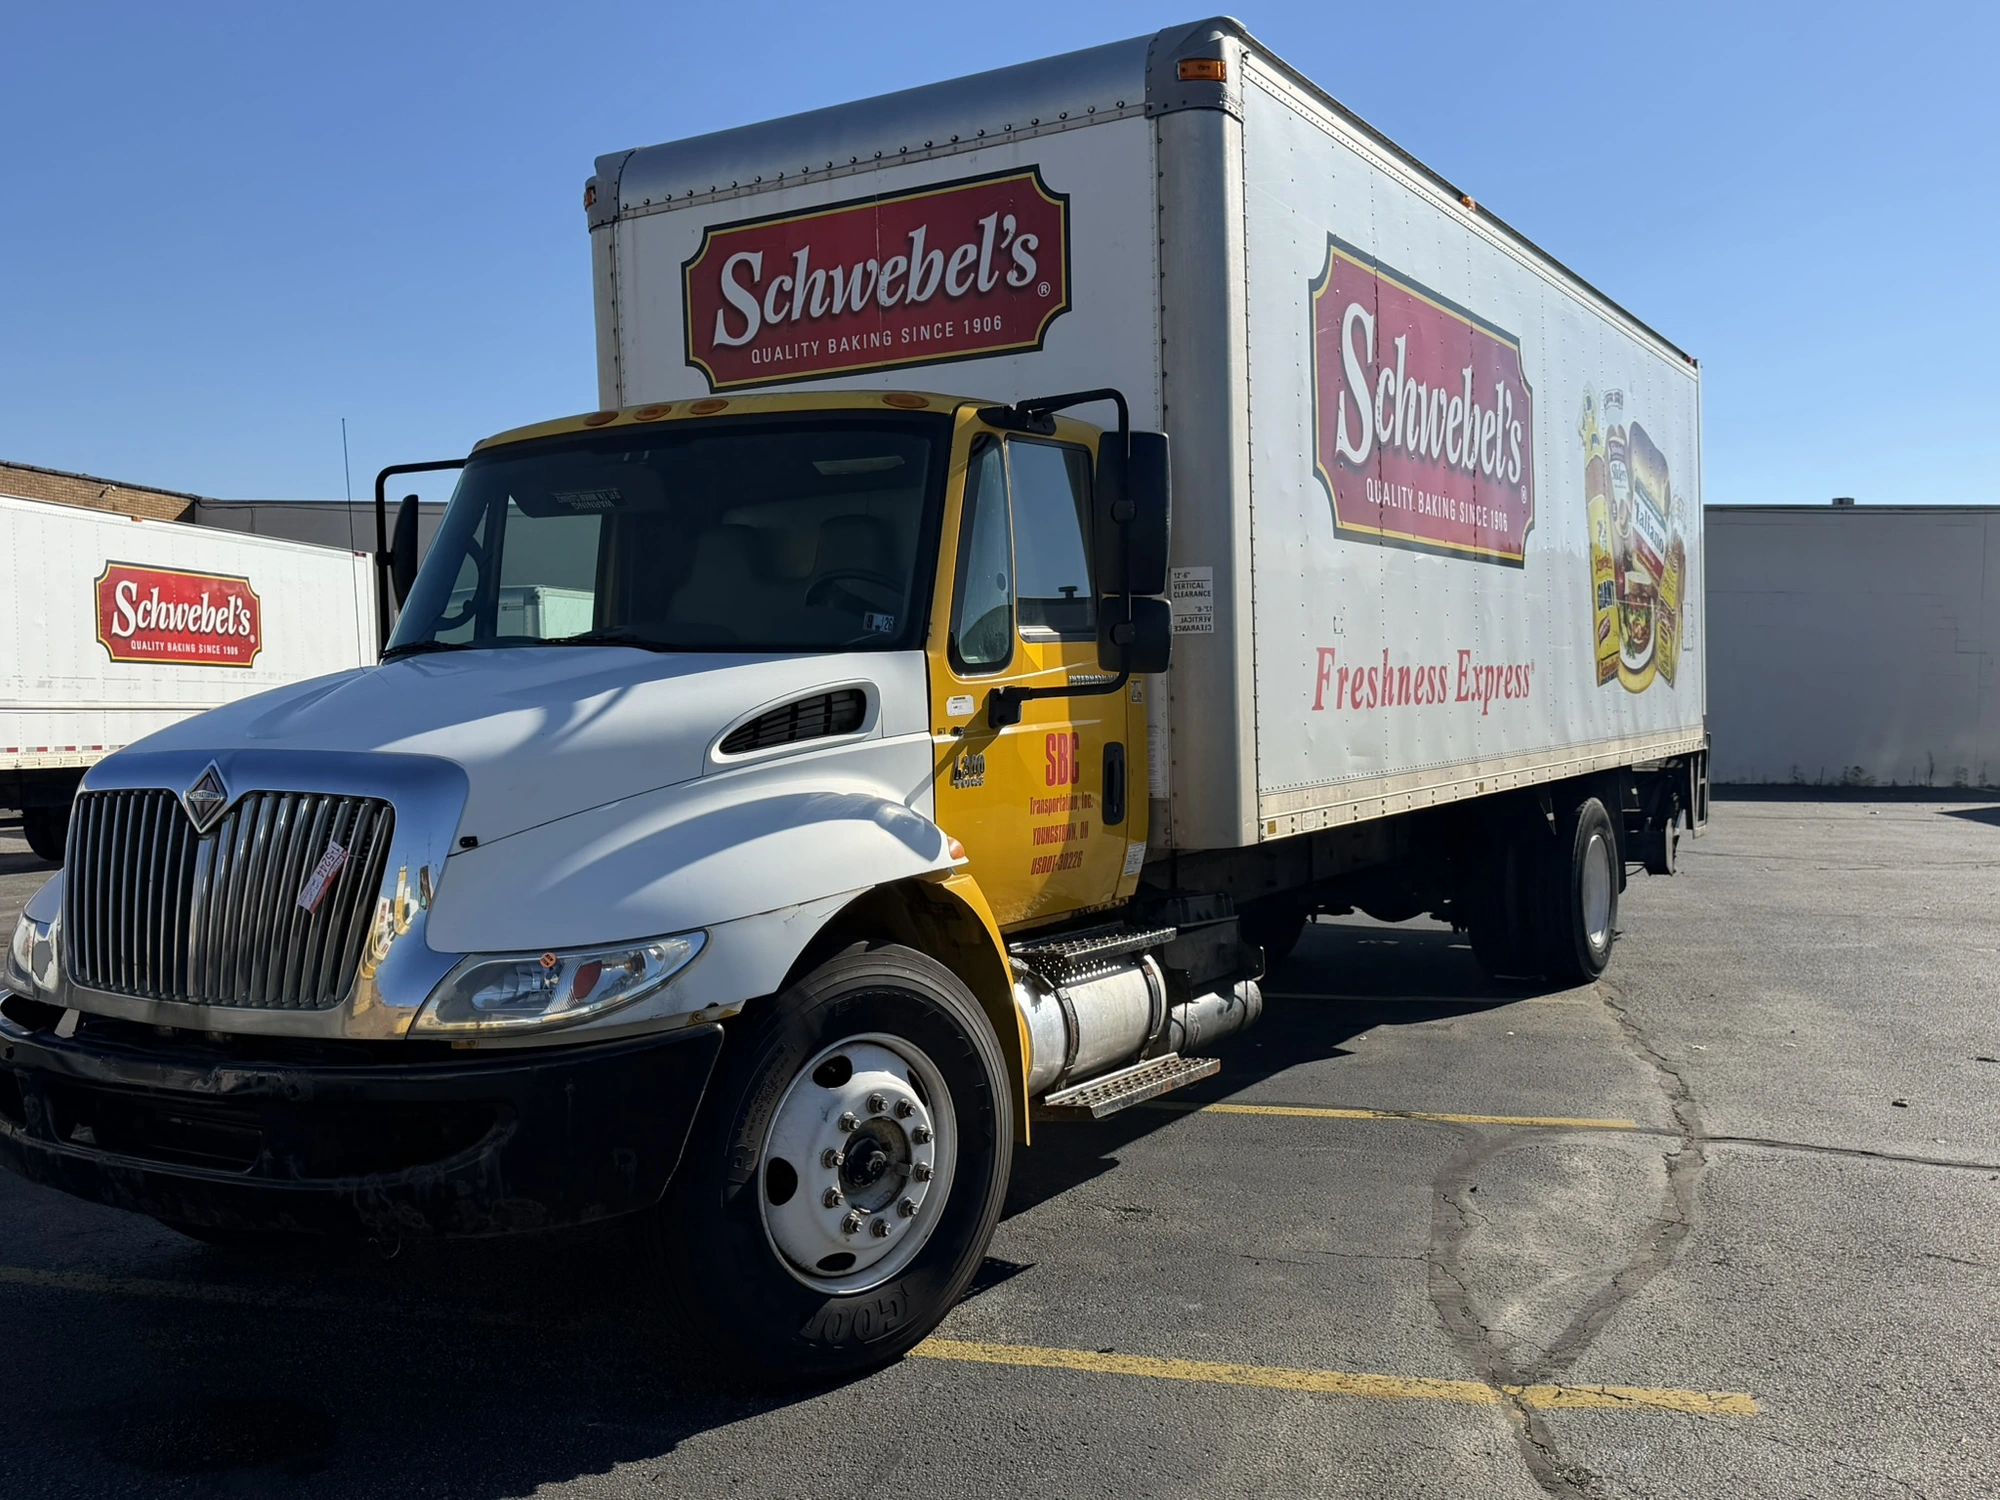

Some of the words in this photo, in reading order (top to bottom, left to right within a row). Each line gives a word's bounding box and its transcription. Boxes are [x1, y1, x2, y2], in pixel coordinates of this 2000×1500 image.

[712, 211, 1039, 348] Schwebel's
[751, 340, 820, 364] QUALITY
[828, 331, 892, 354] BAKING
[901, 322, 954, 344] SINCE
[963, 315, 1002, 335] 1906
[1335, 303, 1522, 484] Schwebel's
[1366, 478, 1413, 511] QUALITY
[1418, 491, 1456, 521] BAKING
[1459, 501, 1488, 527] SINCE
[1491, 510, 1508, 532] 1906
[111, 580, 251, 638] Schwebel's
[1173, 582, 1205, 590] VERTICAL
[1173, 590, 1211, 598] CLEARANCE
[131, 640, 165, 651] QUALITY
[167, 642, 196, 653] BAKING
[198, 644, 221, 654] SINCE
[1311, 647, 1448, 711] Freshness
[1454, 649, 1530, 716] Express
[1045, 732, 1080, 786] SBC
[1030, 793, 1080, 816] Transportation,
[1081, 791, 1094, 809] Inc.
[1033, 823, 1077, 846] YOUNGSTOWN,
[1080, 821, 1089, 839] OH
